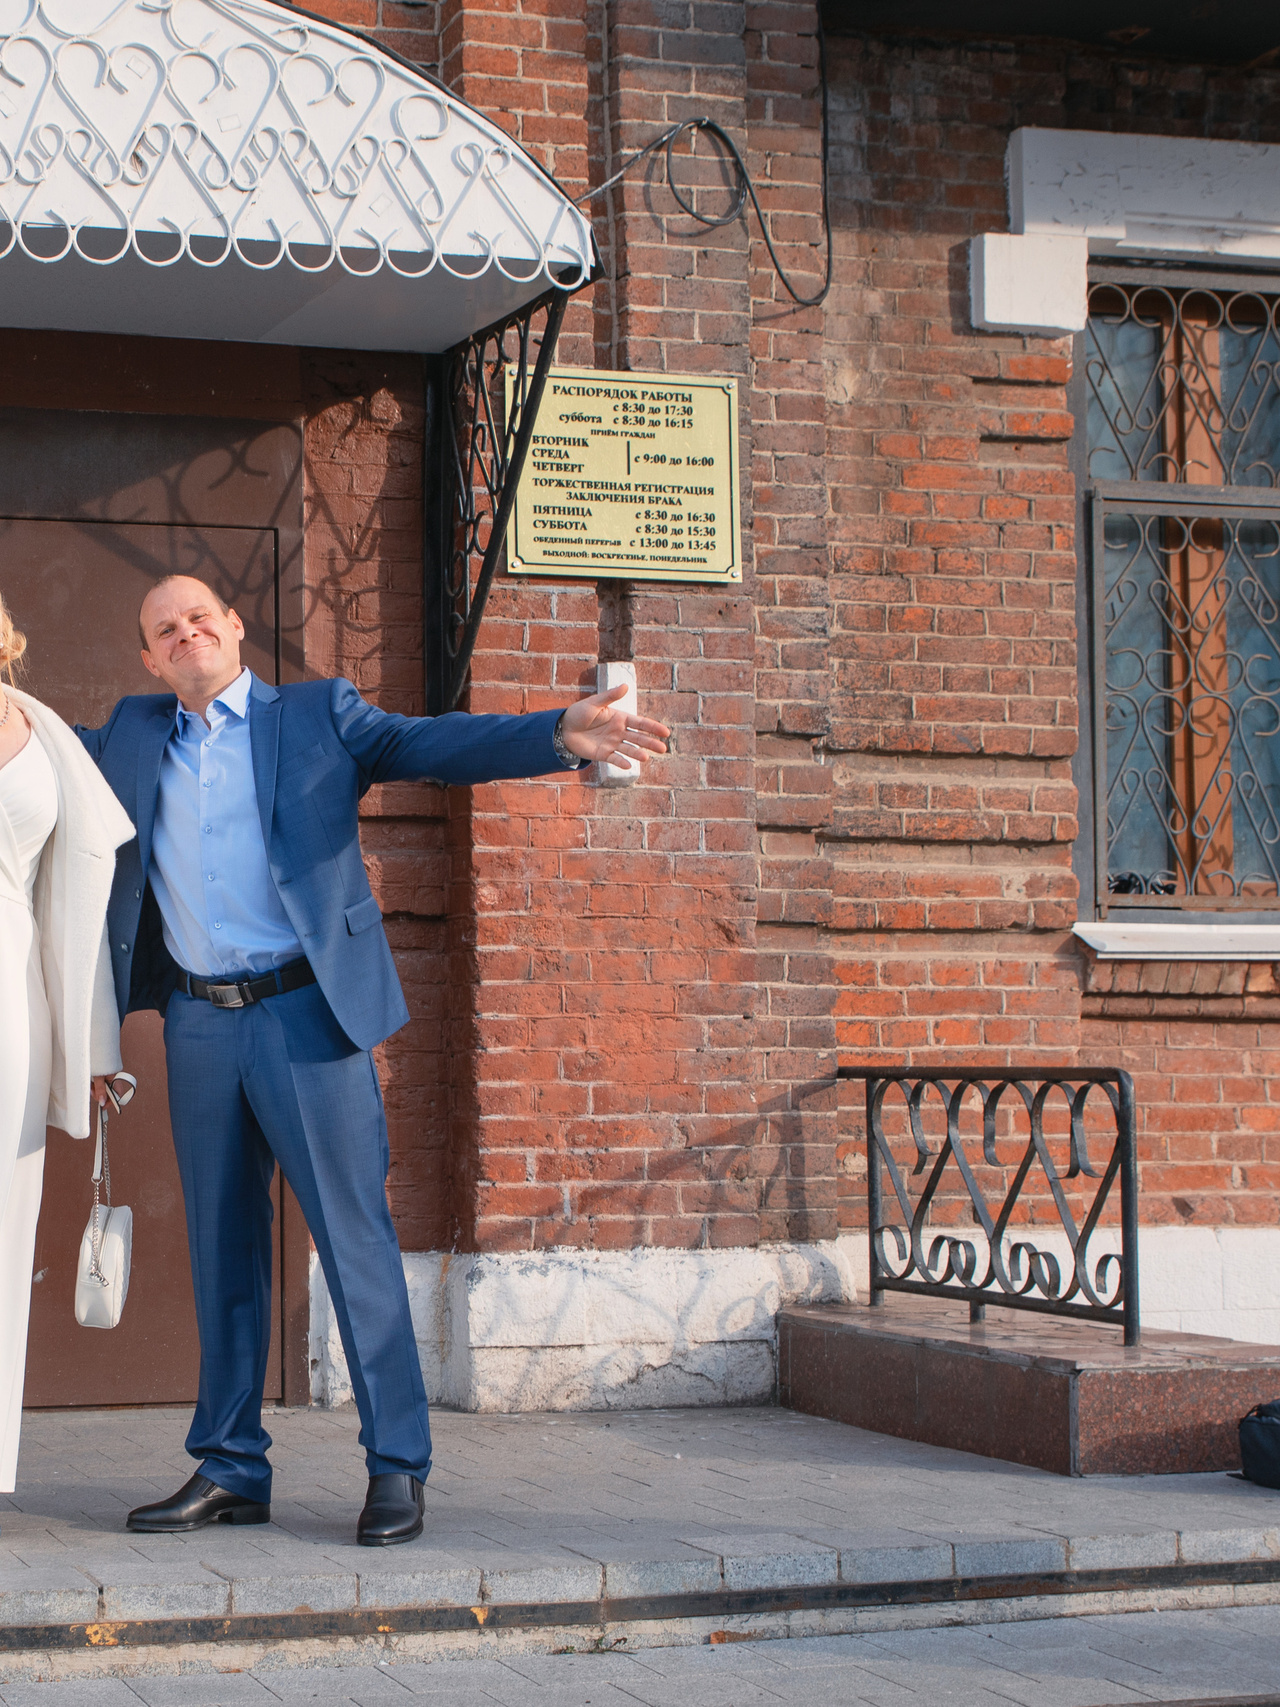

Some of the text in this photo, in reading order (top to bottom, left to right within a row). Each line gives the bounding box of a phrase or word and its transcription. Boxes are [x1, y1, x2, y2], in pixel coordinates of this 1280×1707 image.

[553, 385, 693, 403] РАСПОРЯДОК РАБОТЫ
[613, 404, 619, 412] с
[622, 403, 645, 413] 8:30
[665, 406, 693, 416] 17:30
[559, 412, 602, 424] суббота
[622, 416, 645, 426] 8:30
[665, 418, 693, 429] 16:15
[532, 435, 589, 447] ВТОРНИК
[620, 431, 656, 439] ГРАЖДАН
[532, 449, 570, 459] СРЕДА
[643, 454, 666, 464] 9:00
[686, 456, 714, 466] 16:00
[533, 462, 584, 473] ЧЕТВЕРГ
[532, 478, 714, 496] ТОРЖЕСТВЕННАЯ РЕГИСТРАЦИЯ
[566, 492, 682, 506] ЗАКЛЮЧЕНИЯ БРАКА
[533, 505, 593, 517] ПЯТНИЦА
[644, 510, 668, 520] 8:30
[670, 514, 683, 522] до
[687, 513, 715, 523] 16:30
[533, 520, 588, 531] СУББОТА
[645, 524, 668, 535] 8:30
[688, 527, 716, 537] 15:30
[640, 538, 668, 549] 13:00
[688, 541, 716, 551] 13:45
